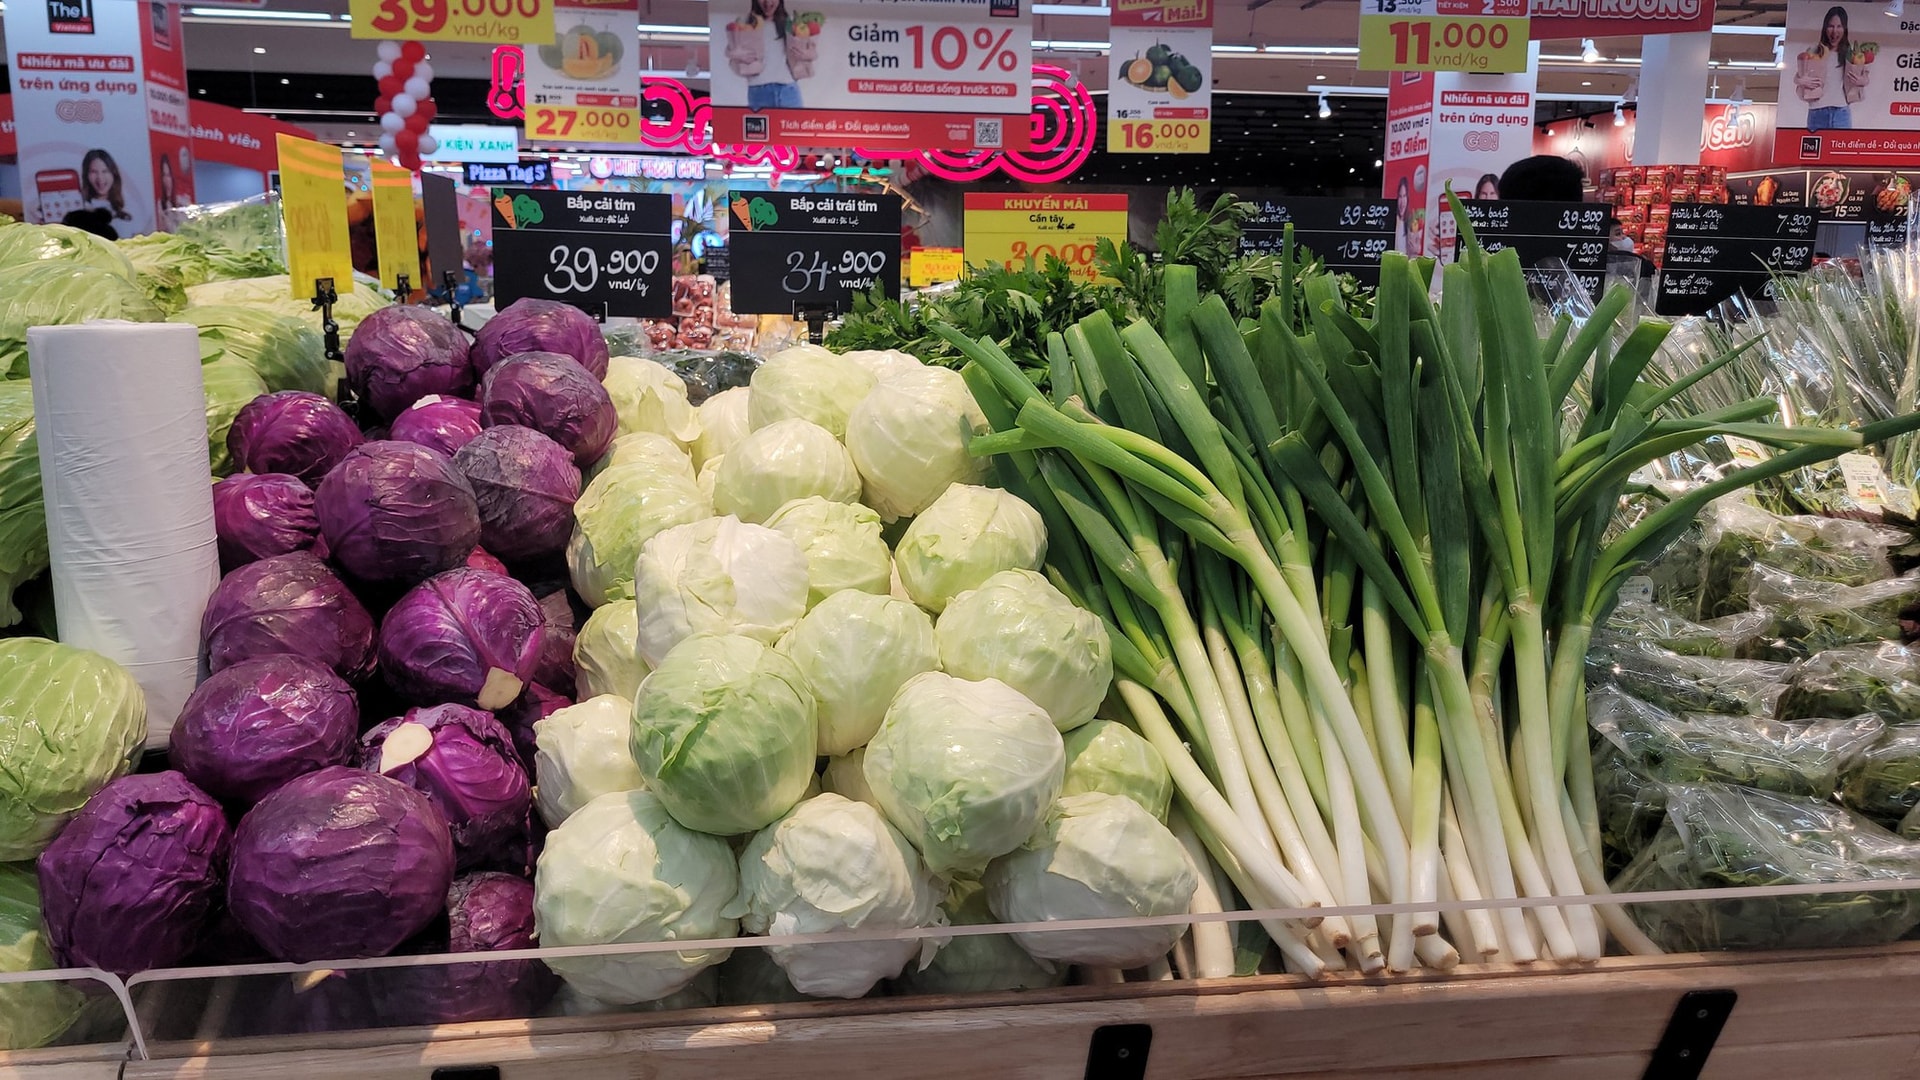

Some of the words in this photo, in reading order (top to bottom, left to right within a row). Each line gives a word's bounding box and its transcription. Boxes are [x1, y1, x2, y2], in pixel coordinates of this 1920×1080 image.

[454, 19, 519, 40] vnd/kg
[848, 24, 900, 43] Giảm
[905, 25, 1018, 72] 10%
[1389, 21, 1508, 65] 11.000
[21, 55, 61, 68] Nhiều
[64, 57, 85, 69] mã
[848, 51, 900, 68] thêm
[1434, 53, 1489, 69] vnd/kg
[20, 78, 53, 90] trên
[59, 77, 90, 93] ứng
[95, 79, 138, 95] dụng
[876, 83, 898, 92] mua
[990, 85, 1009, 95] 10h
[1444, 94, 1474, 104] Nhiều
[1476, 94, 1492, 104] mã
[1494, 96, 1508, 104] ưu
[1510, 95, 1526, 105] đãi
[536, 109, 630, 136] 27.000
[1440, 112, 1465, 123] trên
[1469, 111, 1493, 125] ứng
[1497, 112, 1528, 127] dụng
[1121, 123, 1200, 149] 16.000
[1404, 131, 1428, 154] điểm
[1831, 140, 1846, 149] Tích
[1848, 138, 1866, 149] điểm
[479, 140, 514, 152] XANH
[469, 164, 507, 181] Pizza
[567, 195, 592, 211] Bắp
[594, 198, 612, 210] cải
[614, 198, 635, 211] tím
[790, 196, 815, 212] Bắp
[816, 199, 834, 211] cải
[836, 199, 855, 212] trái
[857, 200, 877, 212] tim
[1004, 195, 1060, 209] KHUYẾN
[1063, 197, 1088, 210] MÃI
[1339, 205, 1389, 225] 39.900
[1558, 210, 1603, 230] 39.900
[1777, 214, 1812, 234] 7.900
[1566, 243, 1603, 265] 7.900
[1767, 246, 1809, 265] 9.900
[544, 245, 659, 293] 39.900
[782, 250, 886, 293] 34.900
[1068, 266, 1098, 281] nd/kg
[608, 277, 650, 297] vnd/kg
